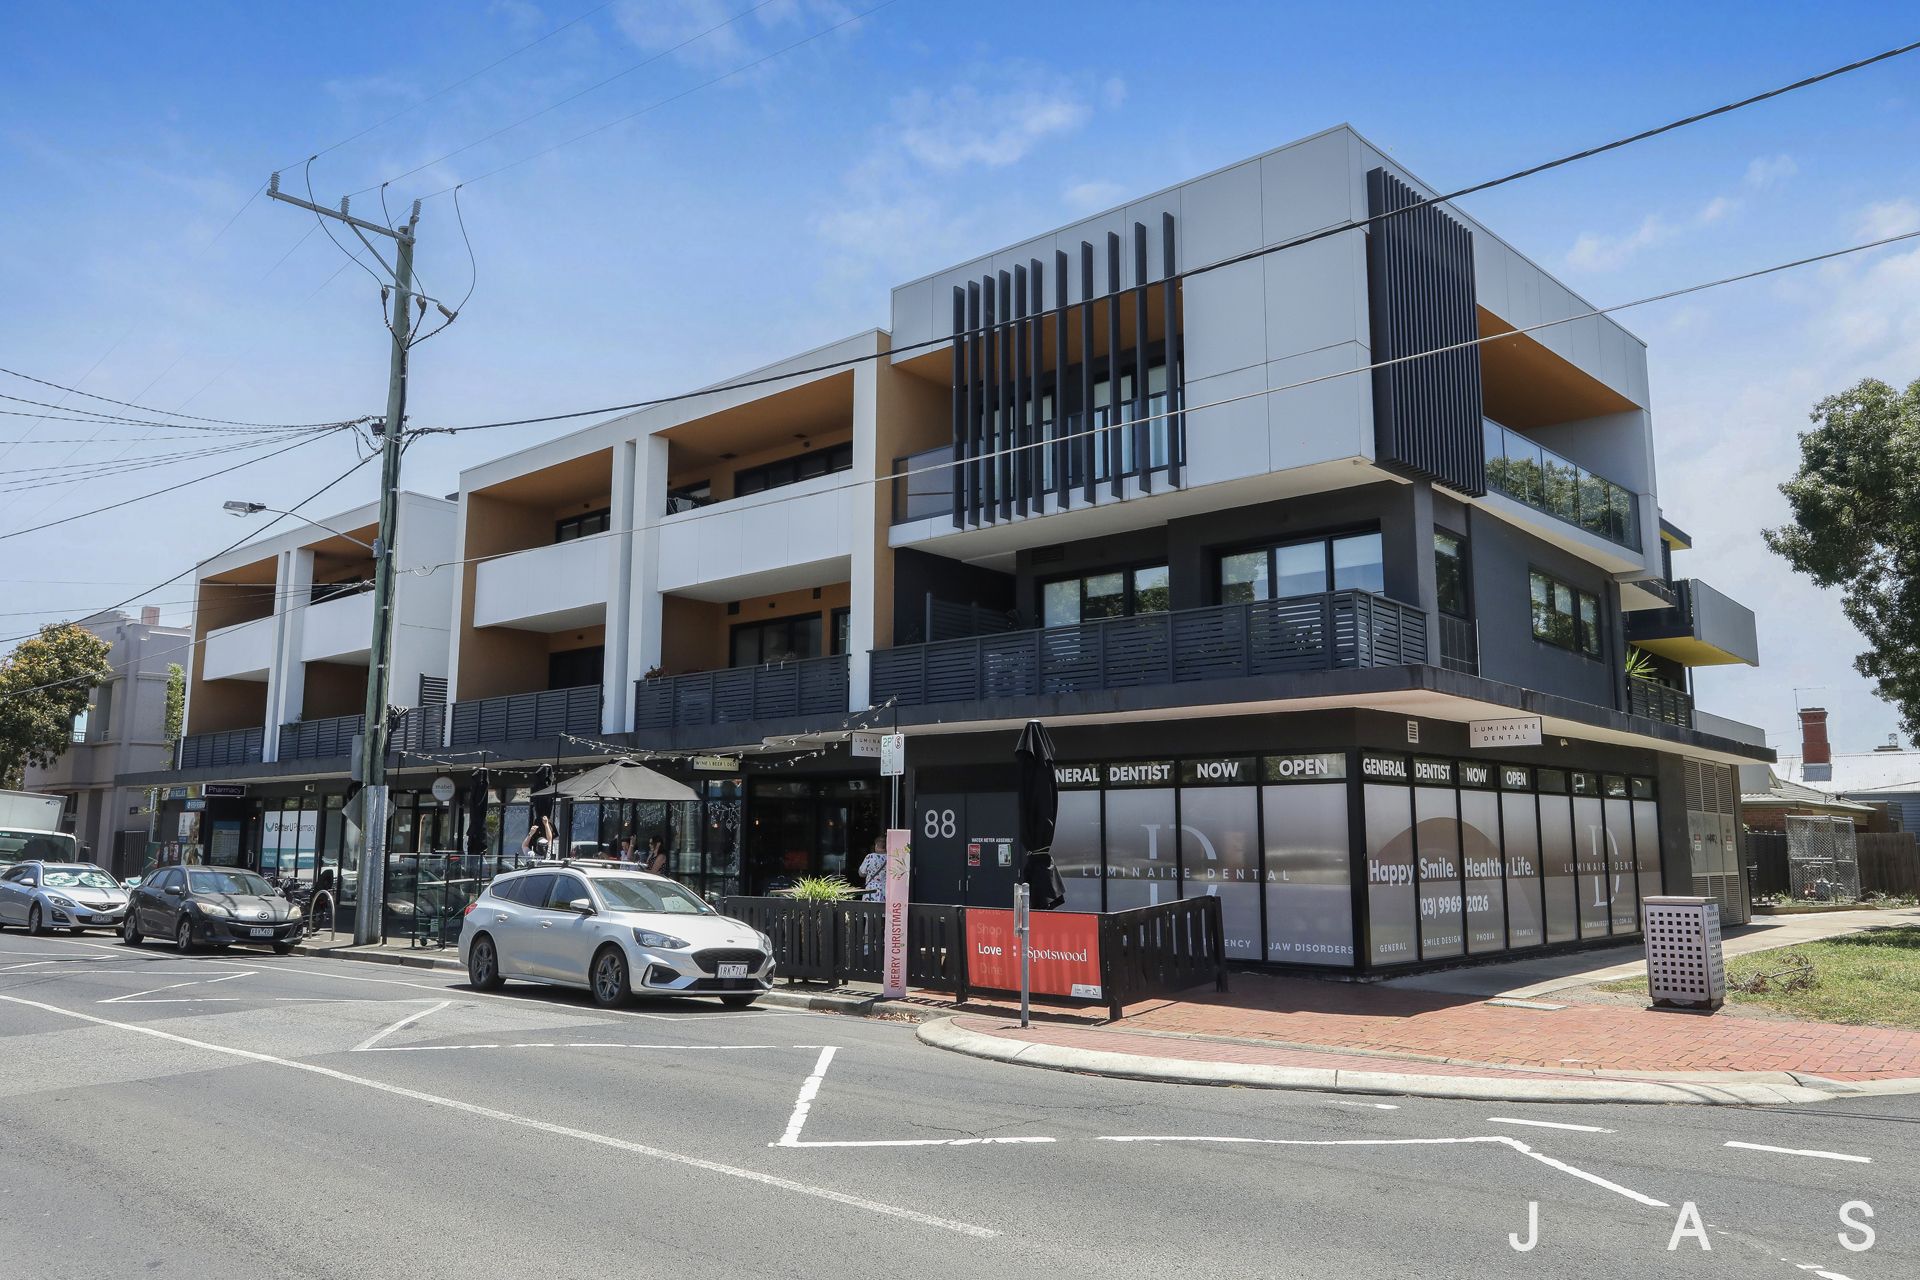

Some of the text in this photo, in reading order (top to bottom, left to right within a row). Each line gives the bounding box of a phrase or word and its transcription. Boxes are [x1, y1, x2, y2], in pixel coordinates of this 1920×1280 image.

[1474, 723, 1537, 732] LUMINAIRE
[882, 737, 892, 748] 2P
[1484, 733, 1527, 742] DENTAL
[1055, 758, 1328, 783] NERAL DENTIST NOW OPEN
[1362, 758, 1527, 786] GENERAL DENTIST NOW OPEN
[208, 786, 241, 795] Pharmacy
[924, 809, 956, 839] 88
[1369, 859, 1415, 886] Happy
[1420, 857, 1457, 880] Smile.
[1512, 856, 1534, 876] Life.
[1564, 861, 1643, 872] LUMINAIR DENTL
[1082, 867, 1290, 881] LUMINAIRE DENTAL
[1420, 894, 1489, 920] (03) 9969 2026
[976, 922, 1002, 937] Shop
[1516, 928, 1535, 936] FAMILY
[1423, 935, 1463, 947] SMILE DESIGN
[1476, 932, 1496, 941] PHOBIA
[891, 902, 902, 988] MERRY CHRISTMAS
[1268, 942, 1353, 955] JAW DISORDERS
[1379, 943, 1407, 953] GENERAL
[978, 942, 1002, 956] Love
[1027, 946, 1088, 963] Spotswood
